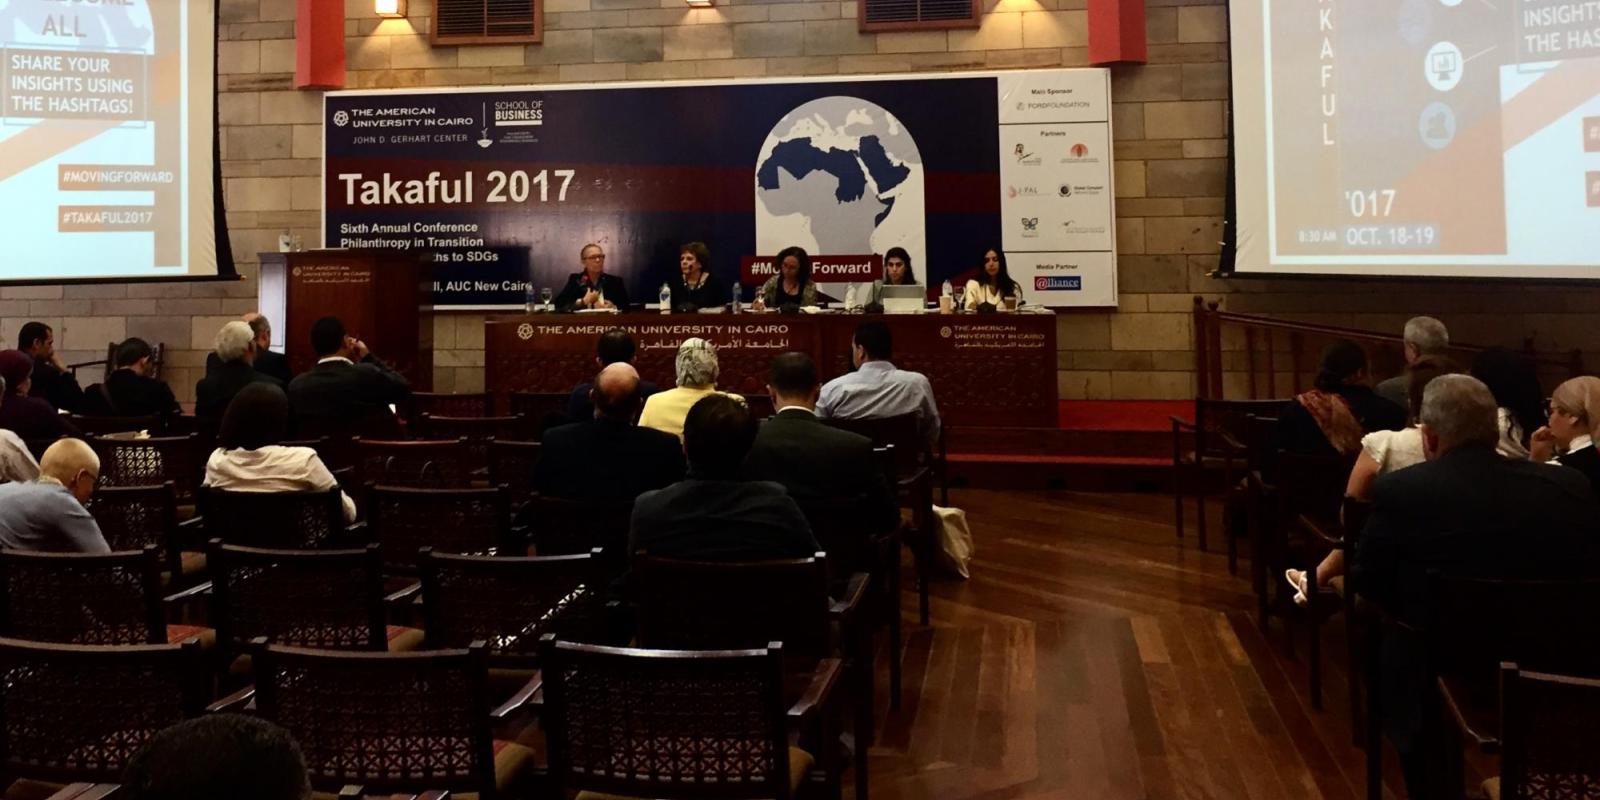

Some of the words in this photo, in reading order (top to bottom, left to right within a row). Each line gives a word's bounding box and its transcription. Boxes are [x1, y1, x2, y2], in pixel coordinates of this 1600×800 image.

[41, 14, 87, 38] ALL
[1524, 32, 1562, 54] THE
[11, 54, 62, 71] SHARE
[67, 57, 110, 73] YOUR
[1319, 0, 1336, 145] KAFUL
[11, 75, 82, 92] INSIGHTS
[87, 78, 133, 94] USING
[11, 96, 43, 111] THE
[48, 97, 133, 114] HASHTAGS!
[376, 107, 436, 116] AMERICAN
[495, 101, 529, 110] SCHOOL
[531, 100, 543, 109] OF
[495, 109, 543, 120] BUSINESS
[353, 119, 421, 128] UNIVERSITY
[437, 117, 474, 126] CAIRO
[353, 136, 376, 144] JOHN
[390, 134, 430, 144] GERHART
[433, 133, 468, 143] CENTER
[63, 170, 173, 183] #MOVINGFORWARD
[338, 171, 473, 205] Takaful
[486, 169, 576, 203] 2017
[63, 210, 152, 224] #TAKAFUL2017
[340, 223, 369, 234] Sixth
[371, 222, 411, 233] Annual
[413, 222, 479, 233] Conference
[340, 238, 411, 250] Philanthropy
[414, 237, 424, 247] in
[427, 236, 484, 247] Transition
[1346, 228, 1382, 245] OCT.
[1388, 227, 1434, 245] 18-19
[452, 252, 464, 262] to
[466, 251, 499, 262] SDGs
[812, 261, 872, 275] Forward
[445, 281, 472, 291] AUC
[474, 281, 499, 291] New
[537, 325, 563, 334] THE
[641, 325, 723, 334] UNIVERSITY
[728, 325, 741, 333] IN
[745, 324, 789, 333] CAIRO
